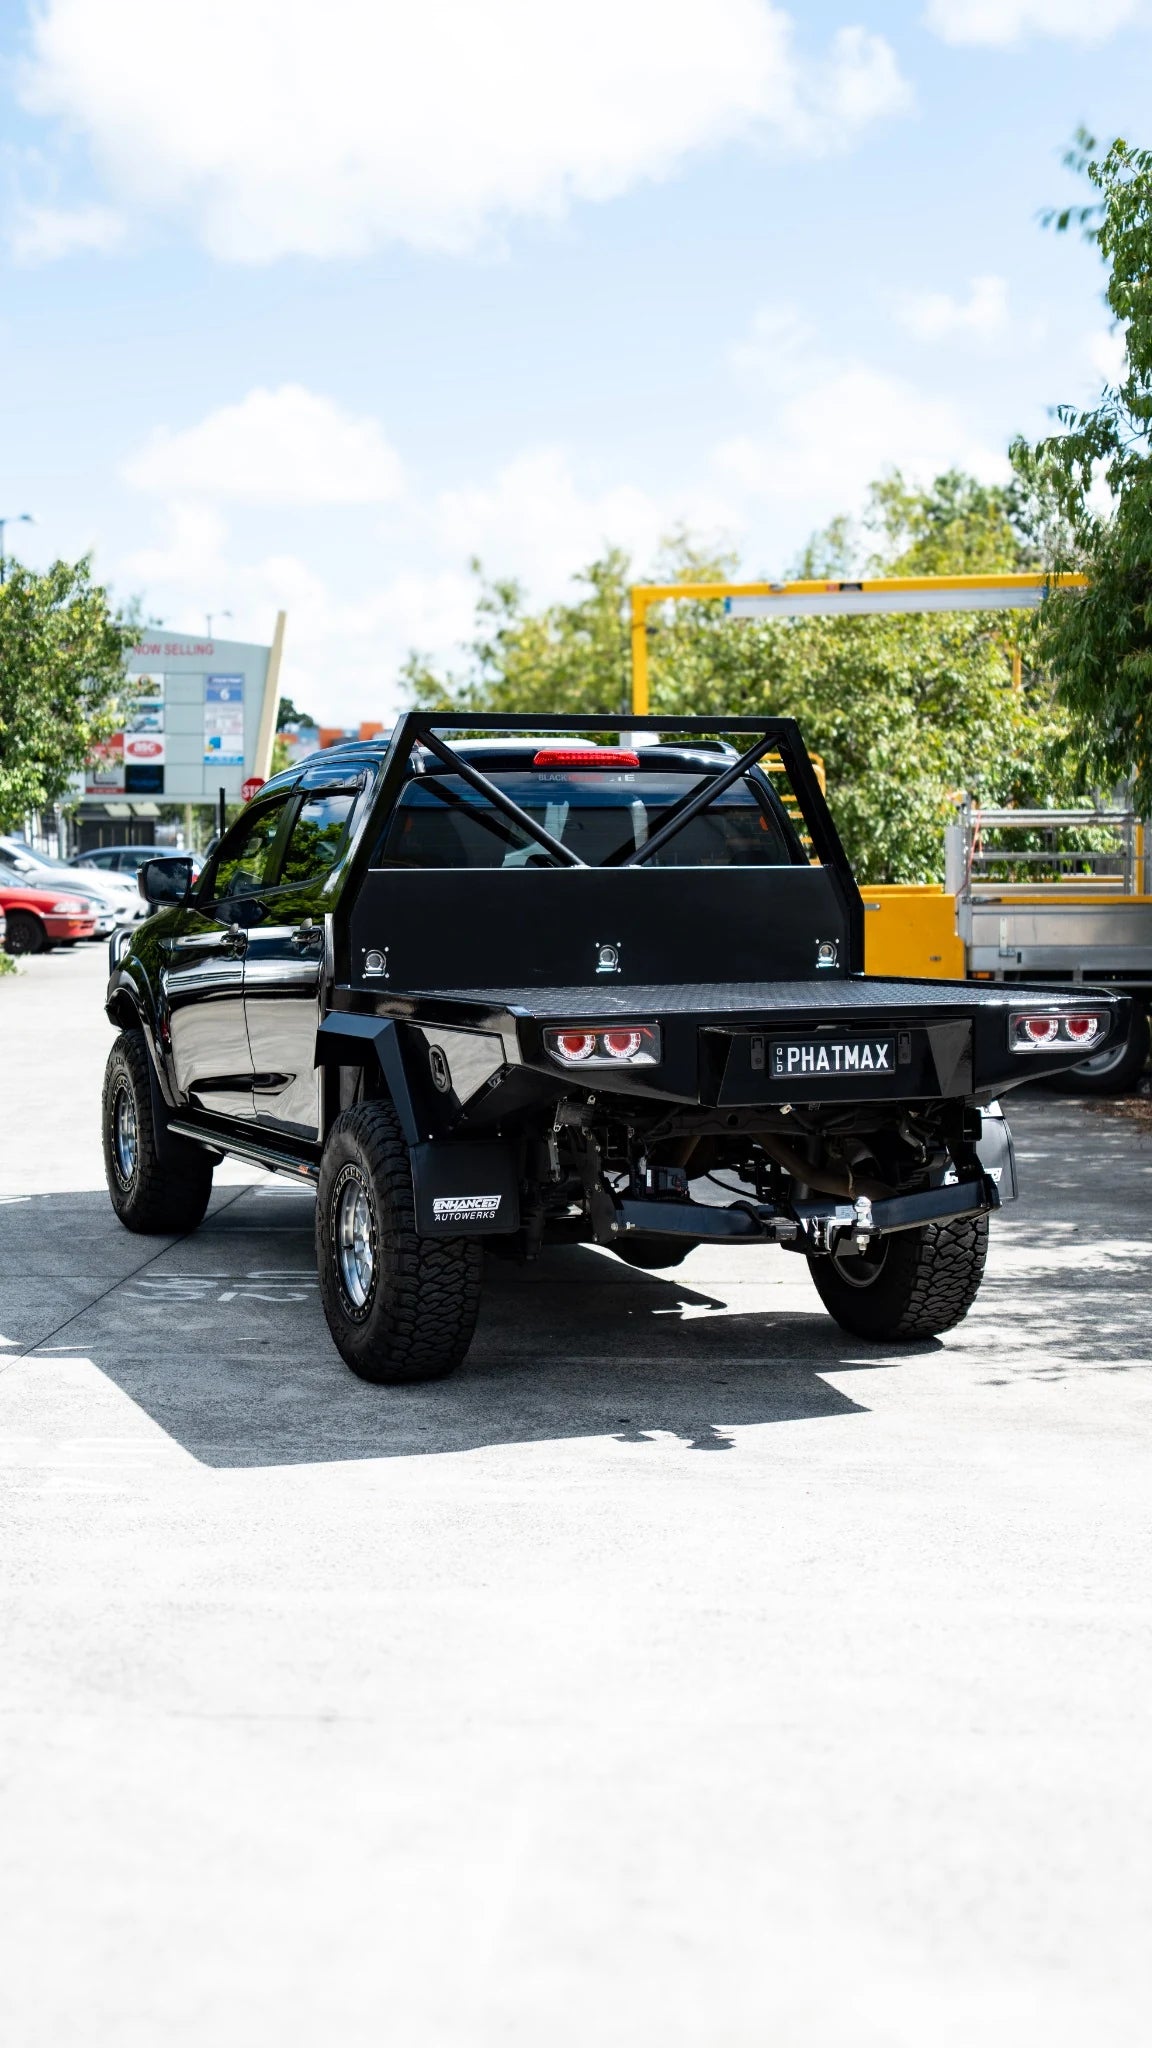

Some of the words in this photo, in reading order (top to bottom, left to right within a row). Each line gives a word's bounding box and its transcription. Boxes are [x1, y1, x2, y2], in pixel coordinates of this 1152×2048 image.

[133, 643, 160, 655] NOW
[164, 643, 214, 656] SELLING
[787, 1044, 889, 1072] PHATMAX
[433, 1198, 499, 1210] ENHANCED
[434, 1211, 496, 1221] AUTOWERKS
